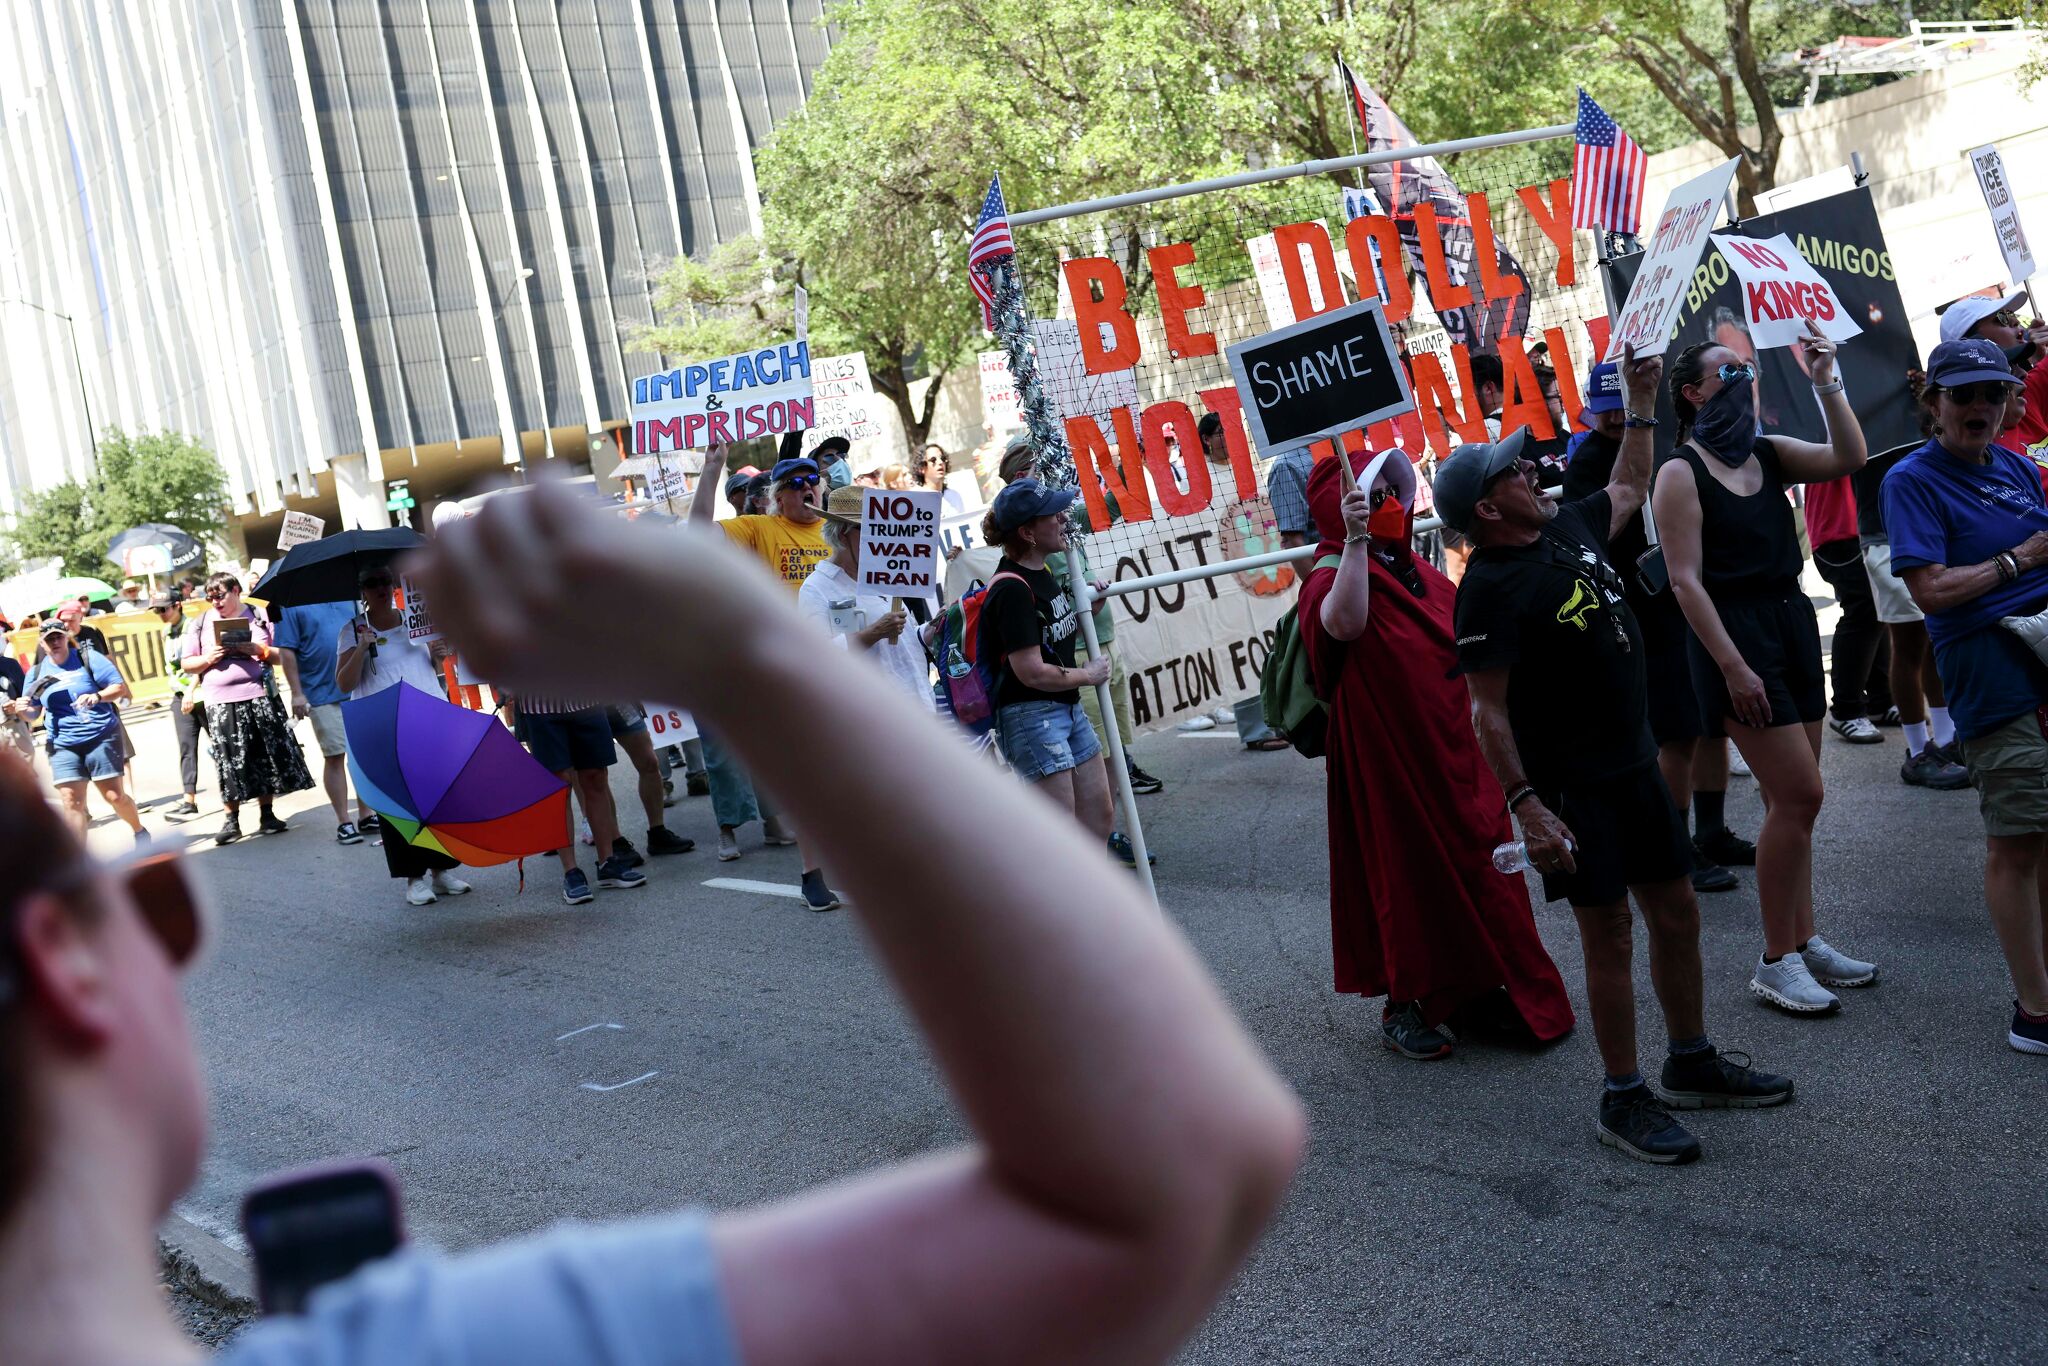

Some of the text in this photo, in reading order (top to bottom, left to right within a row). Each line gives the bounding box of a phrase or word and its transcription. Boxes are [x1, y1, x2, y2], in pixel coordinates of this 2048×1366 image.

[1976, 151, 2001, 171] TRUMP'S
[1982, 168, 2002, 192] ICE
[1988, 187, 2009, 209] KILLED
[1651, 198, 1712, 259] TRUMP
[1728, 241, 1788, 272] NO
[1796, 233, 1895, 281] AMIGOS
[1062, 178, 1576, 376] BE DOLLY
[1747, 281, 1835, 323] KINGS
[635, 341, 811, 404] IMPEACH
[982, 361, 1004, 372] LIED
[1252, 335, 1373, 408] SHAME
[852, 380, 864, 393] IN
[990, 392, 1010, 403] ARE
[705, 394, 723, 411] &
[636, 396, 815, 454] IMPRISON
[849, 408, 867, 422] NO
[1064, 387, 1258, 533] NOT
[868, 496, 934, 521] NO to
[868, 523, 933, 538] TRUMP'S
[780, 548, 829, 557] MORONS
[781, 556, 801, 564] ARE
[867, 541, 932, 558] WAR
[886, 559, 910, 571] on
[1115, 530, 1218, 623] OUT
[865, 571, 929, 586] IRAN
[1129, 648, 1222, 727] ATION
